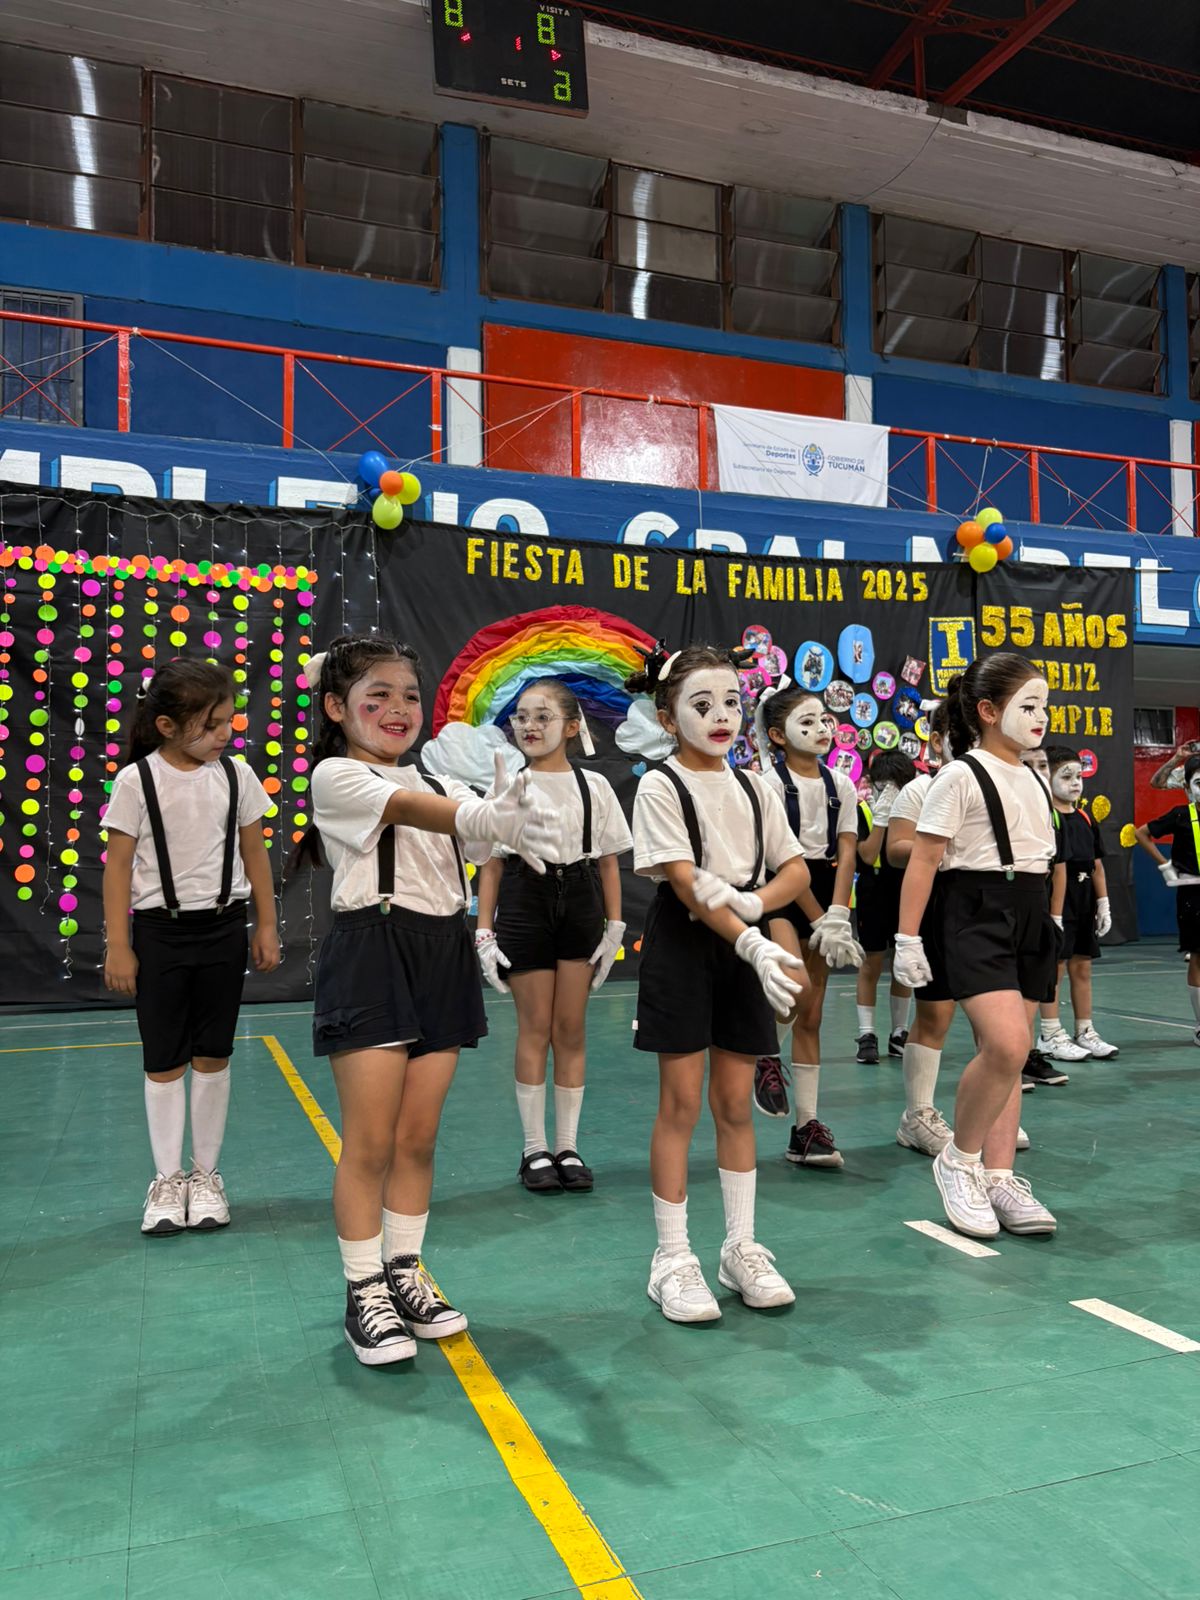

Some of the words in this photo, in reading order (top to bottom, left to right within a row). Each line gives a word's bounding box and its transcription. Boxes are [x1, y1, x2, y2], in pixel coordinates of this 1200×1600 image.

[539, 4, 571, 17] VISITA
[537, 12, 556, 46] 8
[500, 77, 527, 88] SETS
[766, 450, 796, 460] Deportes
[827, 455, 857, 464] GOBIERNO
[827, 461, 866, 473] TUCUMÁN
[467, 537, 585, 586] FIESTA
[613, 553, 650, 592] DE
[676, 558, 708, 596] LA
[728, 562, 844, 602] FAMILIA
[861, 569, 929, 602] 2025
[981, 604, 1036, 648] 55
[1043, 602, 1128, 649] AÑOS
[1048, 704, 1114, 736] MPLE
